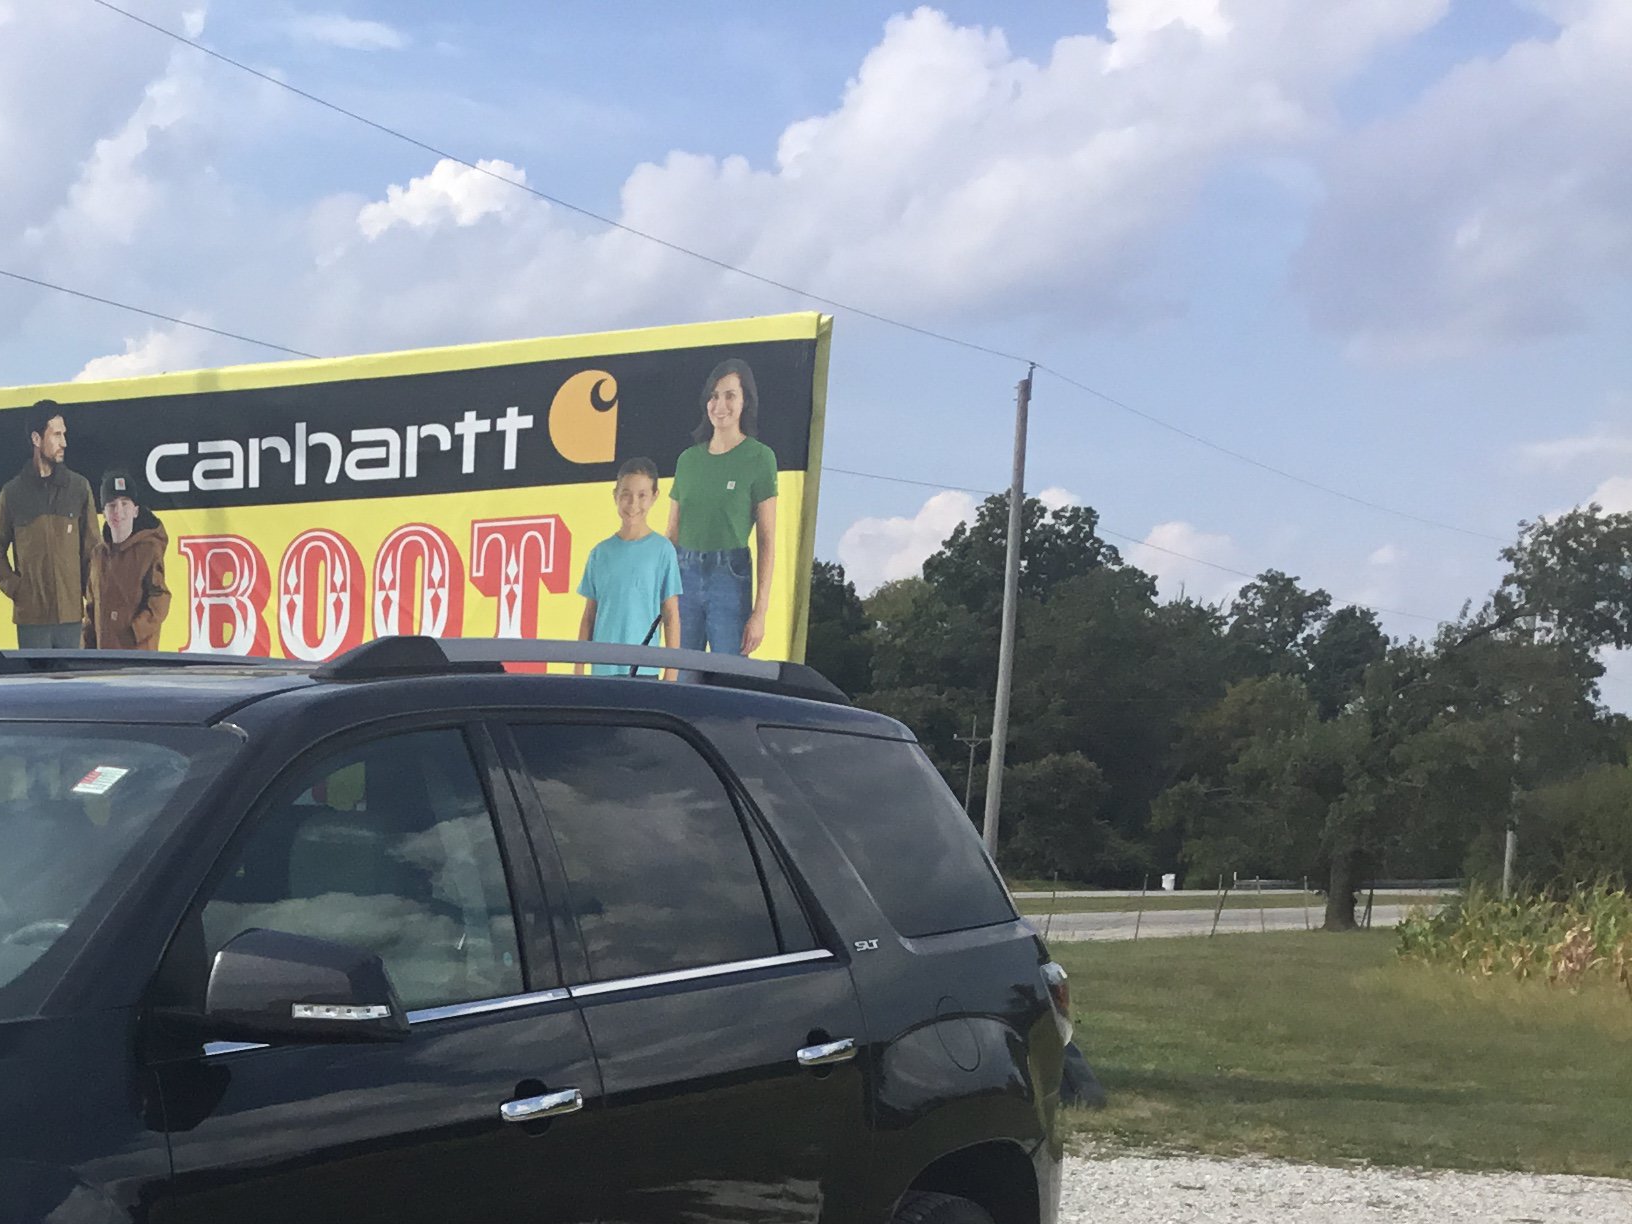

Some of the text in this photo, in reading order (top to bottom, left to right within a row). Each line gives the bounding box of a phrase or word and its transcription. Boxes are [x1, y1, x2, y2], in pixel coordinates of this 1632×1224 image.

[145, 406, 534, 493] carhartt
[178, 513, 572, 674] BOOT
[854, 938, 879, 952] SLT
